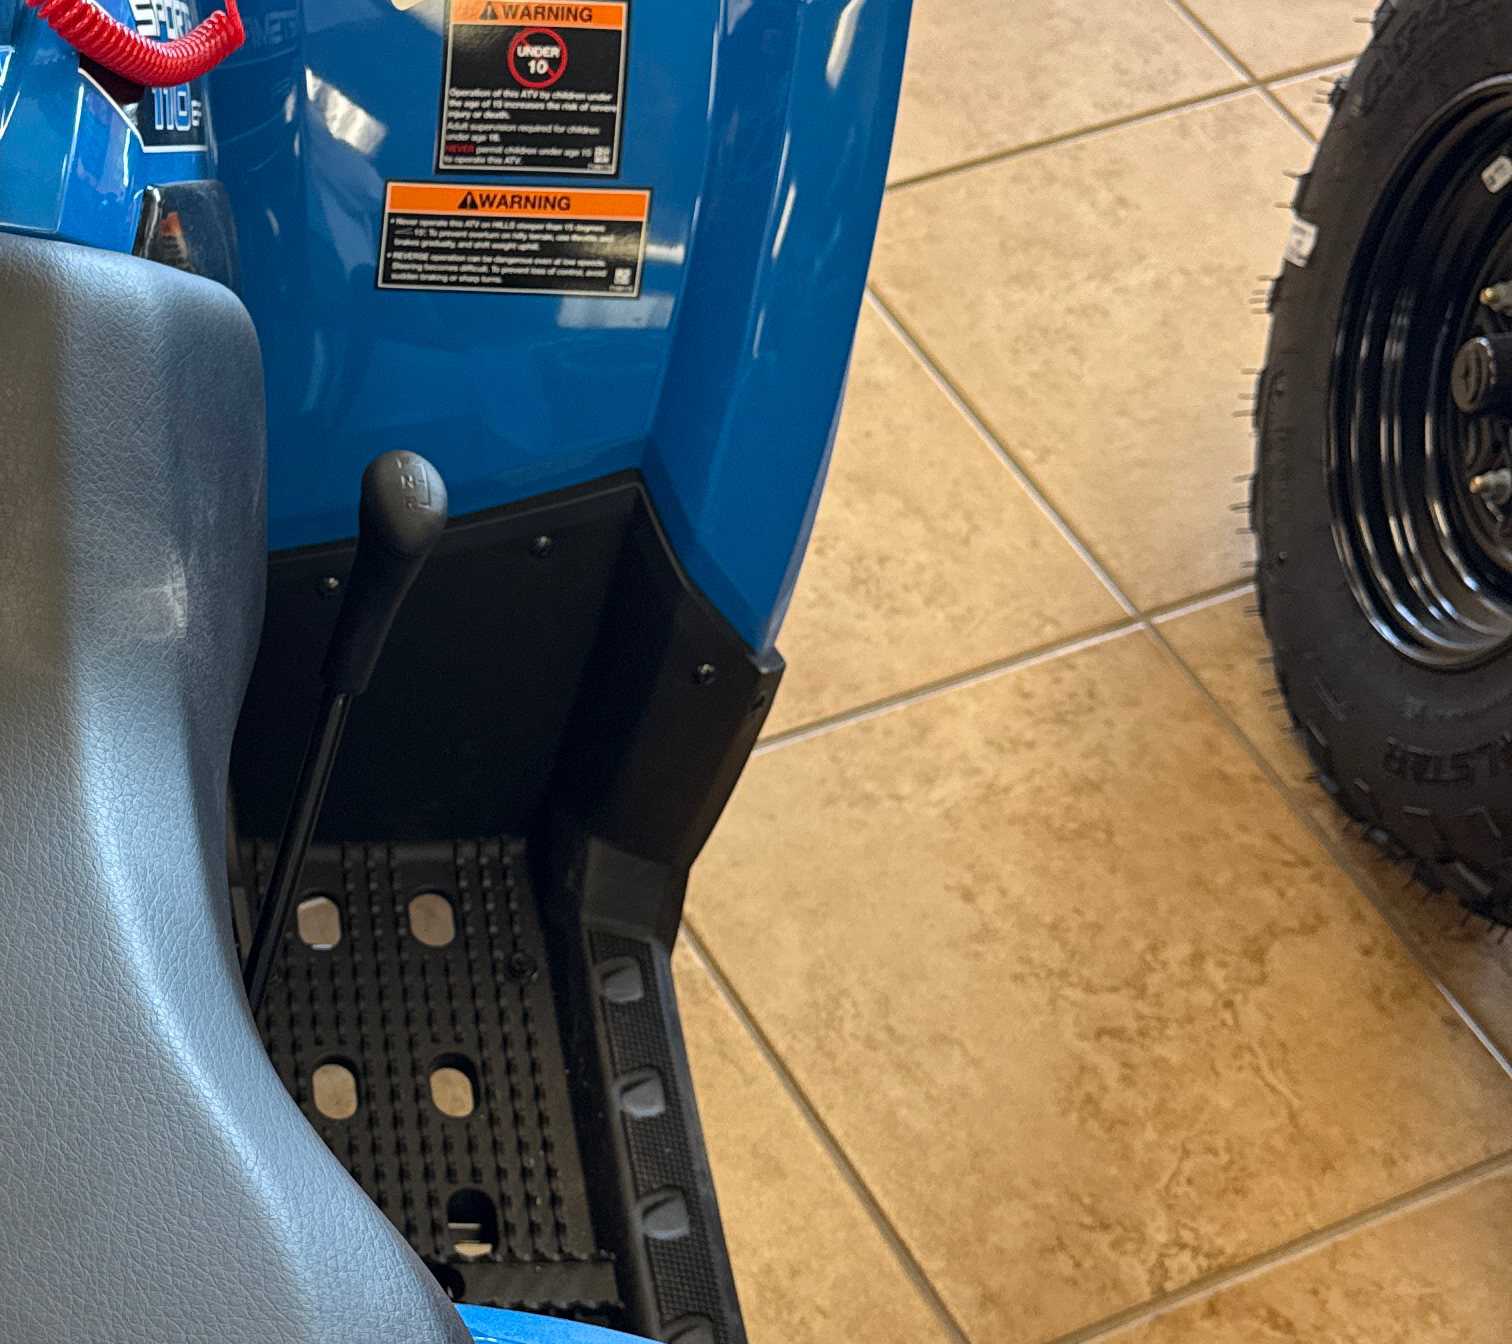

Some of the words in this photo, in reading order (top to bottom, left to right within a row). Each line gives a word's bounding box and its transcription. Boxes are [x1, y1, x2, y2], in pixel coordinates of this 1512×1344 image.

[501, 3, 593, 22] WARNING
[516, 46, 561, 59] UNDER
[527, 60, 549, 74] 10
[152, 82, 191, 131] 110
[478, 194, 572, 211] WARNING
